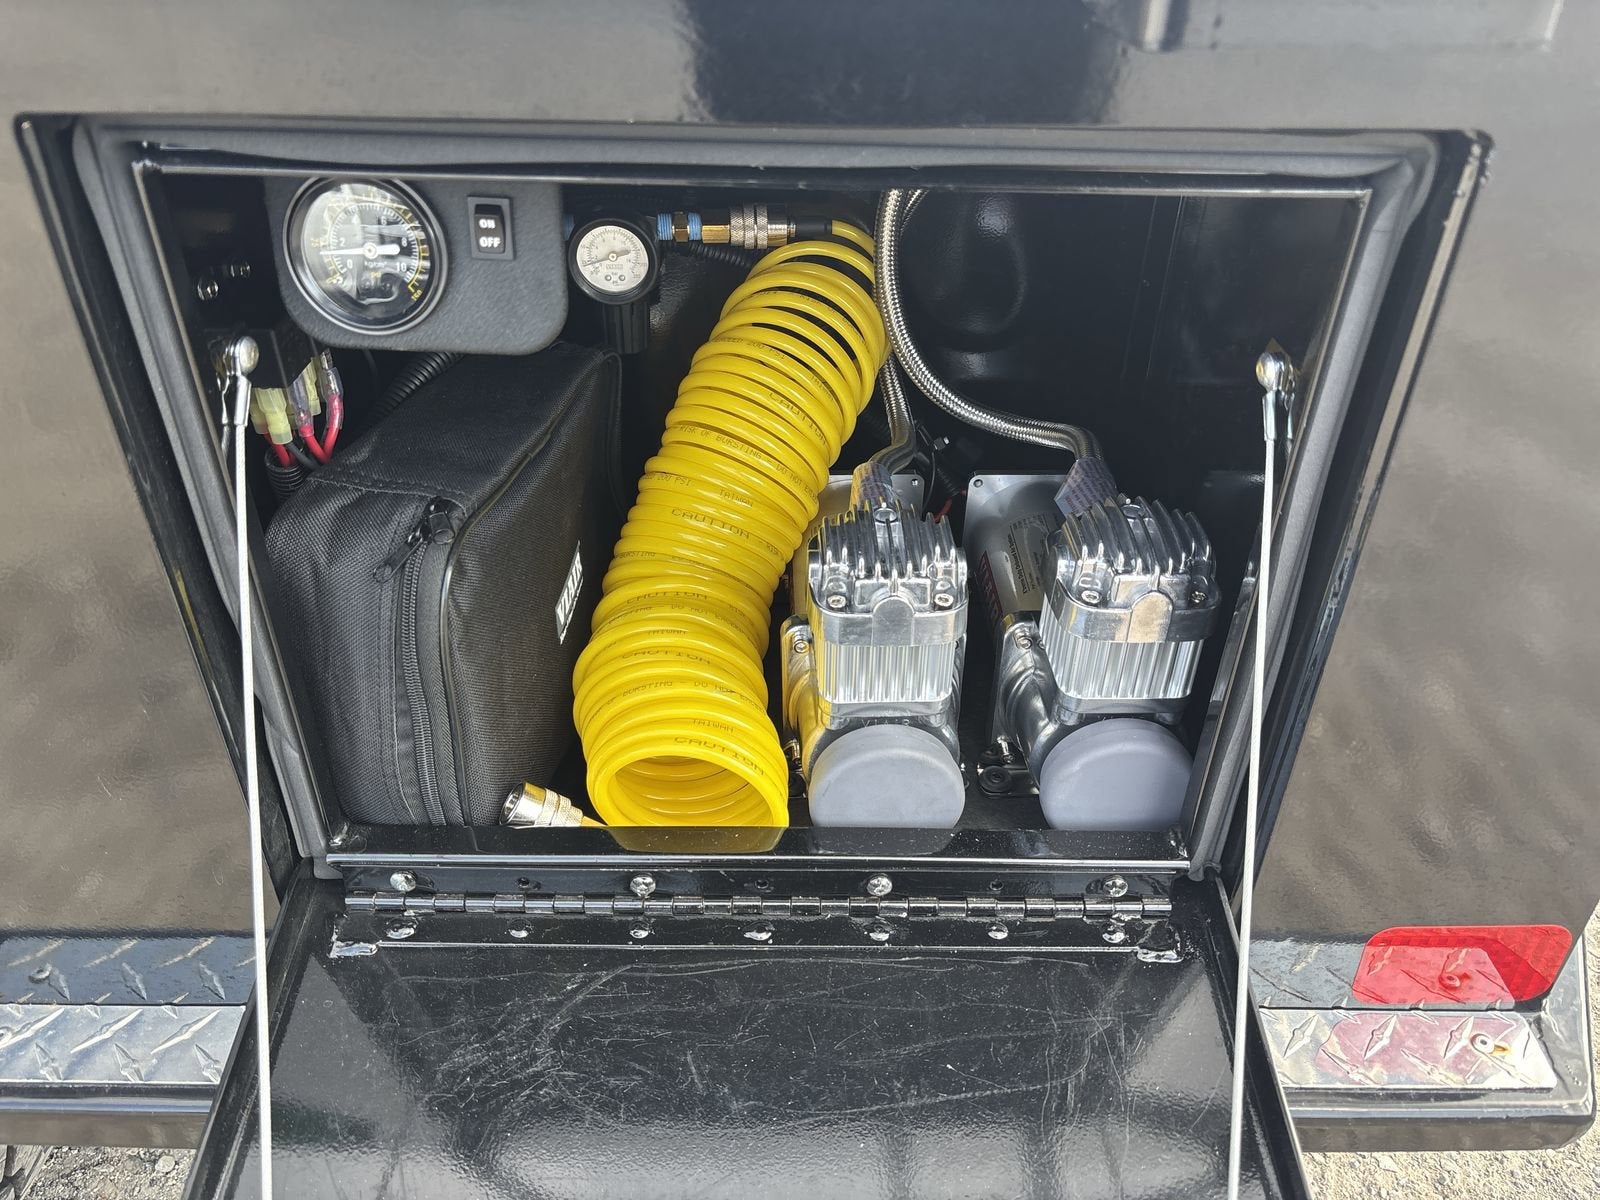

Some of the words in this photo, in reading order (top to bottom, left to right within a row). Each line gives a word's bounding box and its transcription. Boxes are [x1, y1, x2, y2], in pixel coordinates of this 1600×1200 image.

[479, 218, 496, 229] ON
[339, 237, 346, 247] 2
[401, 237, 408, 248] 8
[479, 236, 501, 248] OFF
[346, 258, 353, 269] 0
[396, 262, 407, 272] 10
[715, 434, 763, 460] BURSTING
[671, 507, 751, 540] CAUTION
[673, 736, 765, 776] CAUTION
